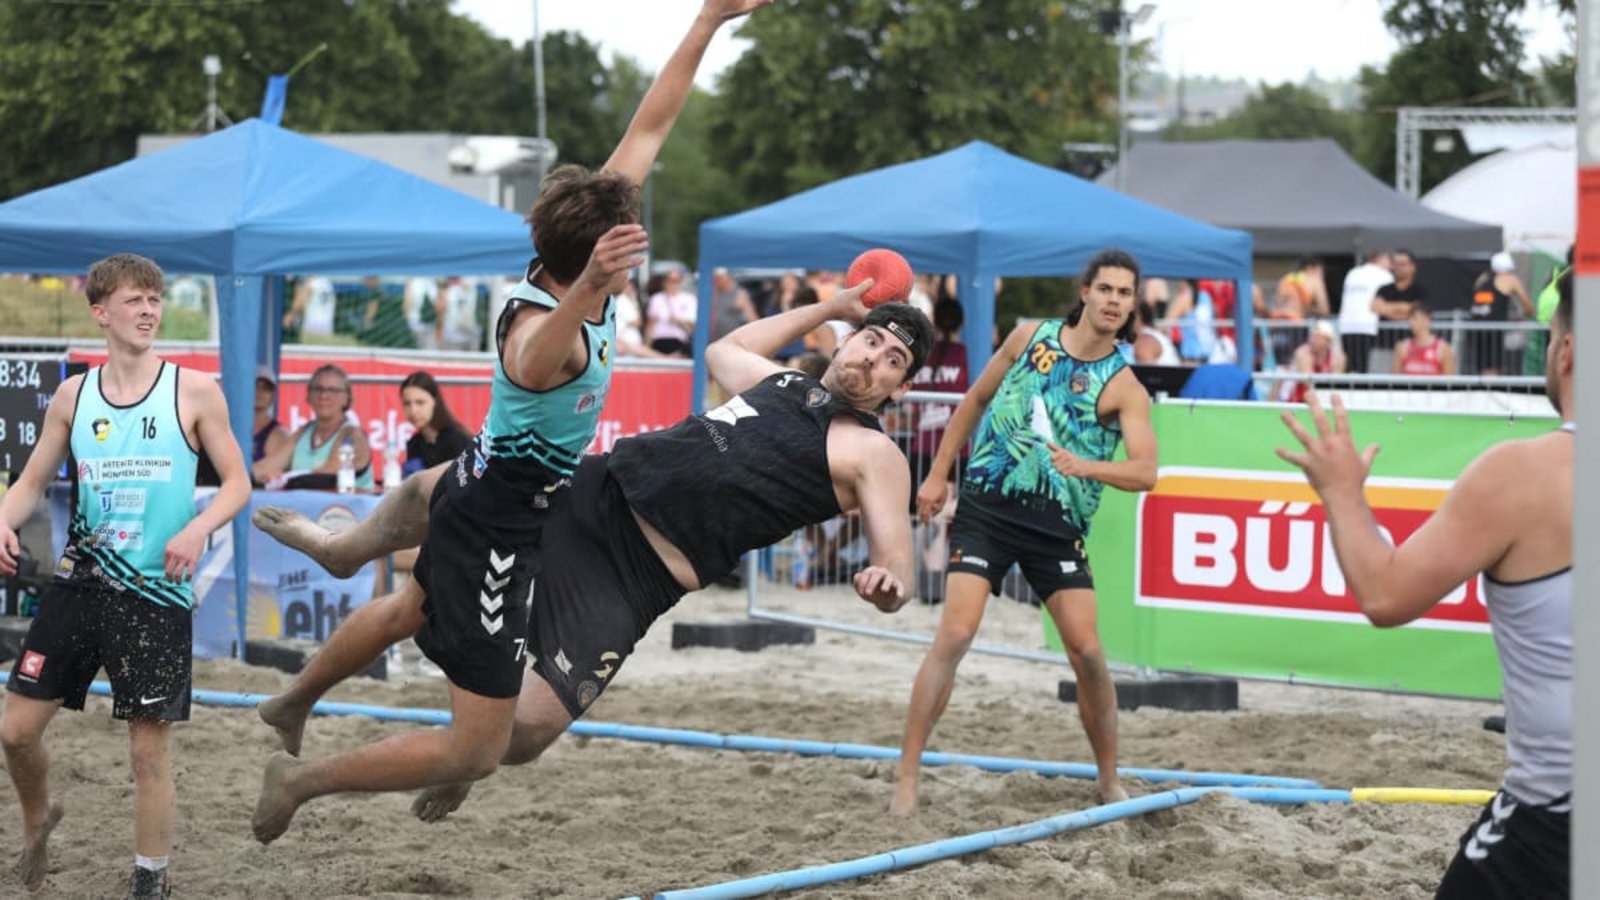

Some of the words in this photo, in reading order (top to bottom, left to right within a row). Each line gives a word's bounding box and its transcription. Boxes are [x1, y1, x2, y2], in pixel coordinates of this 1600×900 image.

[1031, 342, 1057, 374] 26
[18, 421, 37, 446] 18
[141, 416, 157, 440] 16
